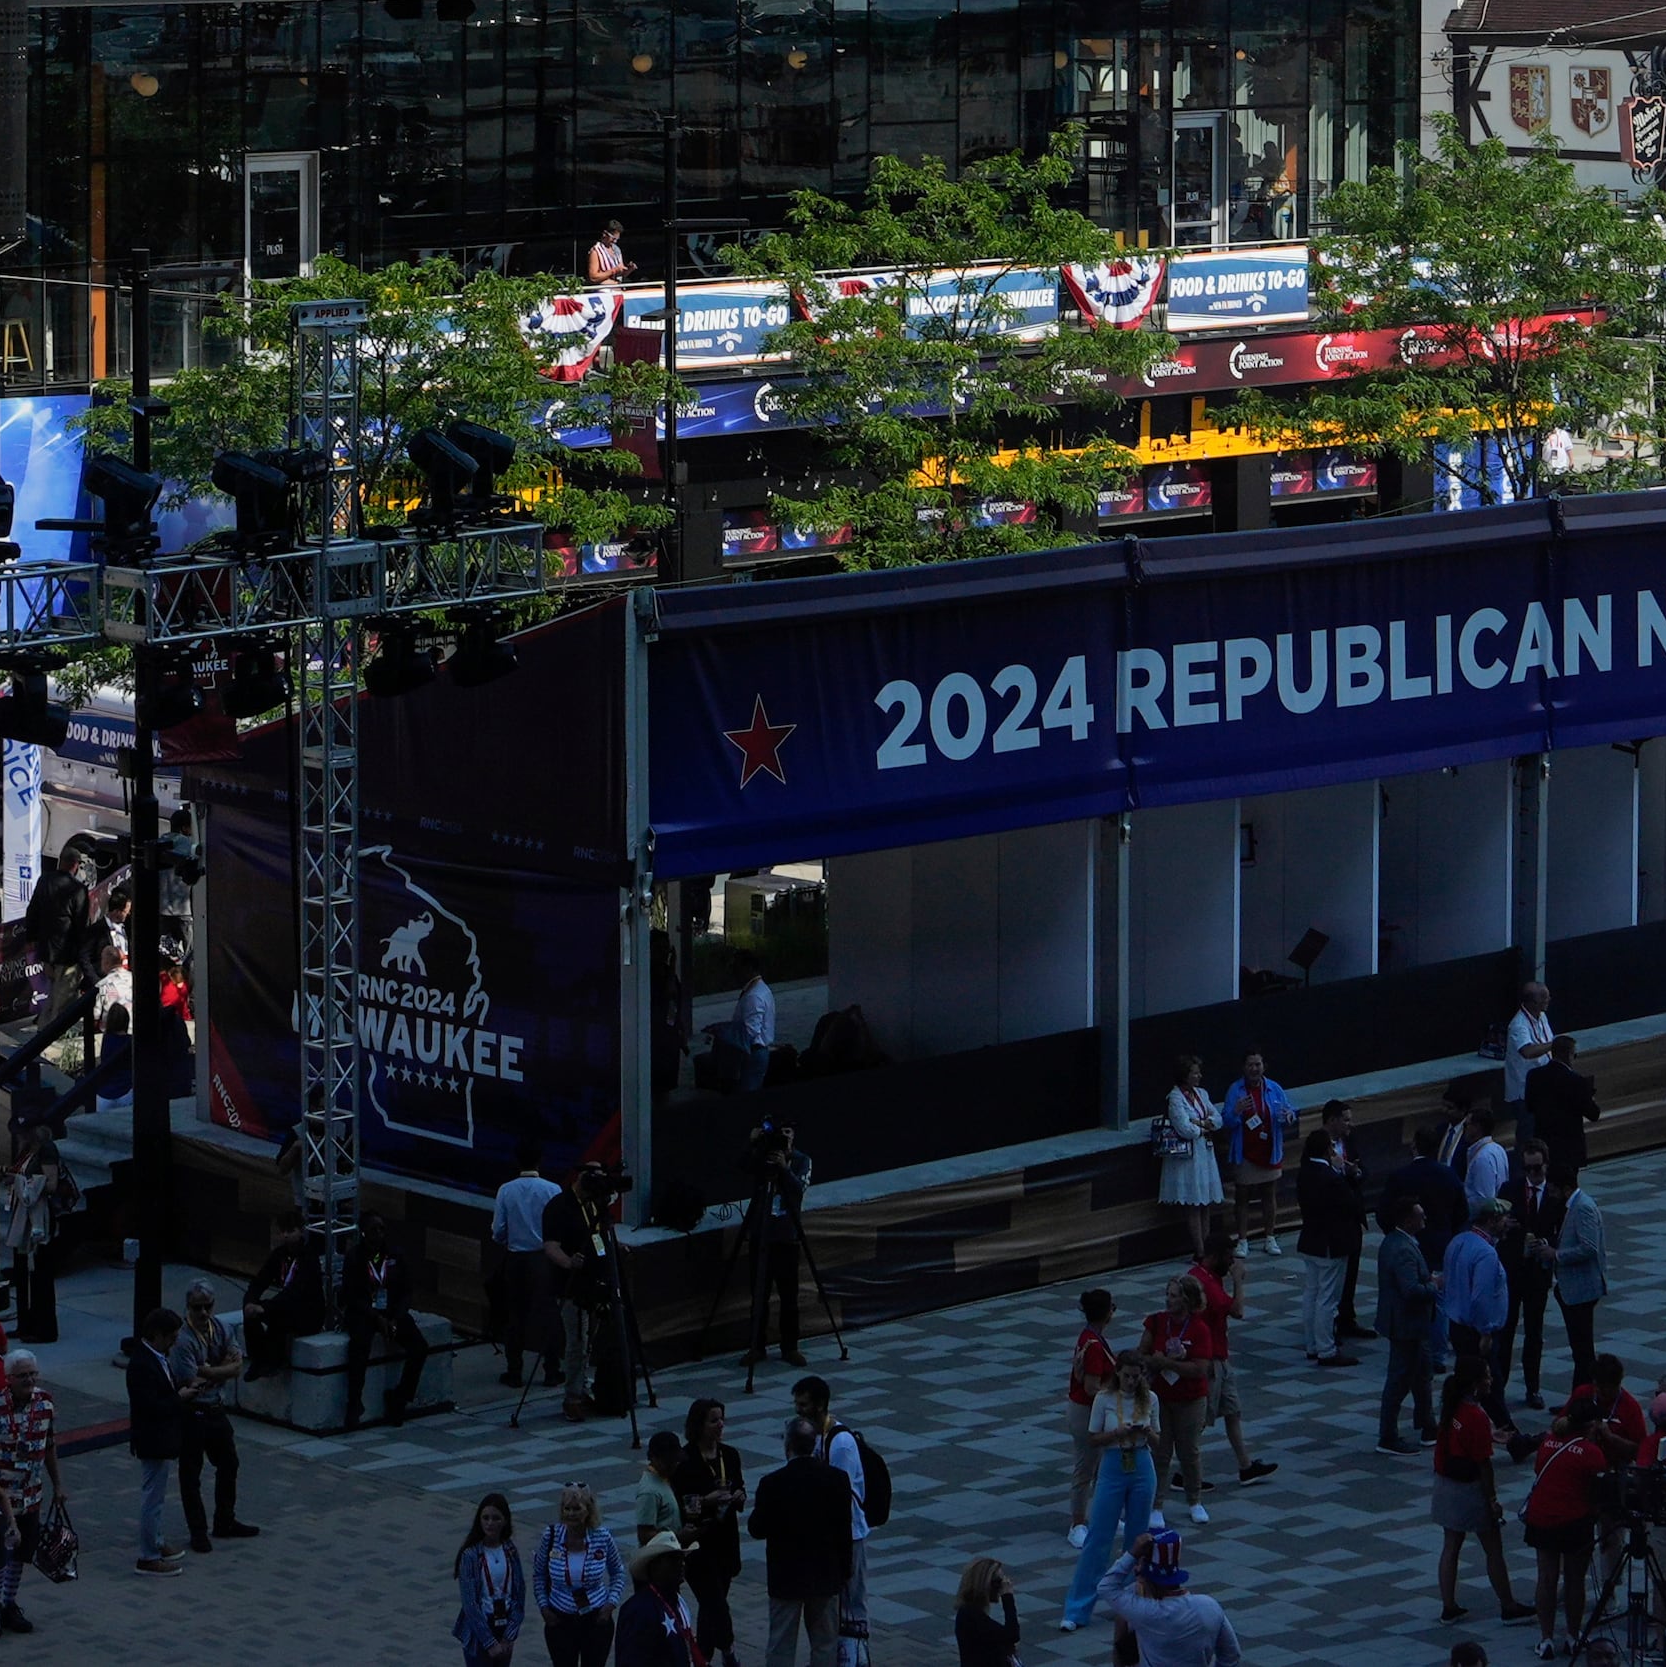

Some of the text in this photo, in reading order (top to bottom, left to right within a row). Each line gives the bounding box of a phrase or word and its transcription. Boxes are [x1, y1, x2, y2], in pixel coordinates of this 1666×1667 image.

[266, 243, 284, 255] PUSH
[1170, 268, 1306, 298] FOOD & DRINKS TO-GO
[315, 308, 350, 319] APPLIED
[683, 308, 740, 332] DRINKS
[743, 304, 788, 326] TO-GO
[875, 655, 1094, 770] 2024
[1116, 594, 1612, 734] REPUBLICAN
[90, 725, 100, 743] &
[357, 974, 456, 1017] RNC 2024
